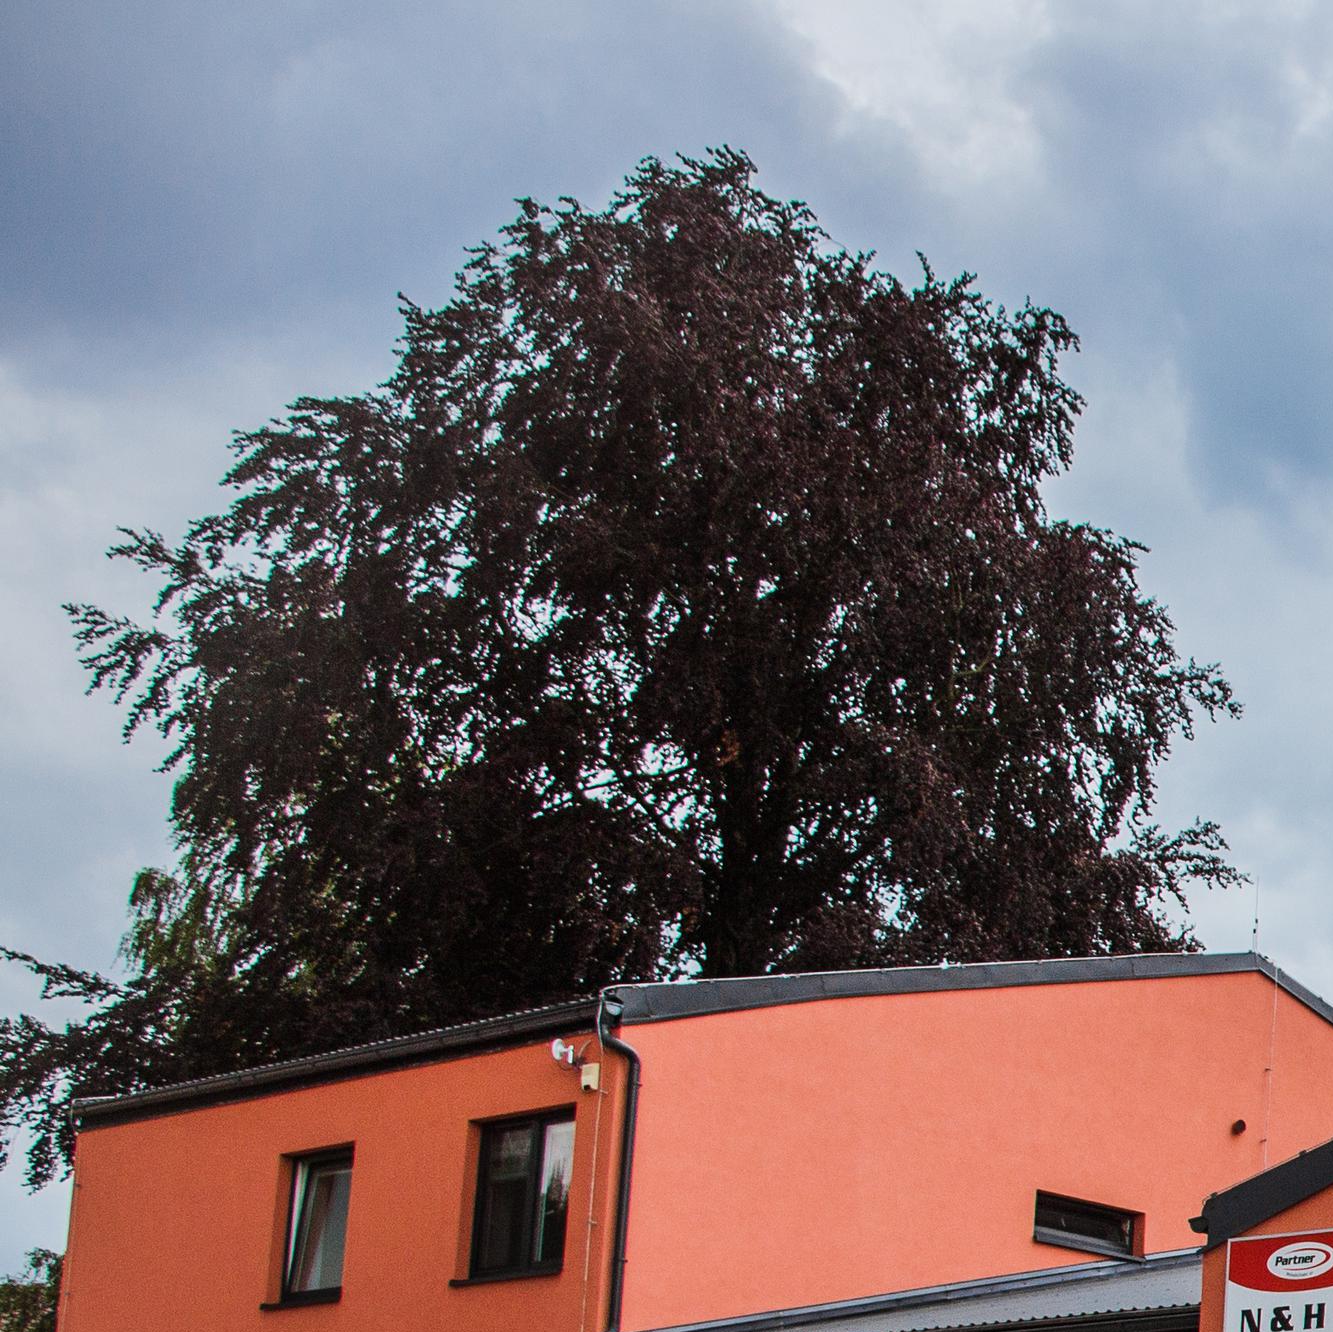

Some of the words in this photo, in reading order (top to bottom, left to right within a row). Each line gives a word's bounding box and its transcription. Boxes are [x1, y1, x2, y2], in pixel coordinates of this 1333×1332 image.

[1275, 1255, 1315, 1266] Partner
[1270, 1305, 1294, 1332] &
[1303, 1303, 1325, 1330] H
